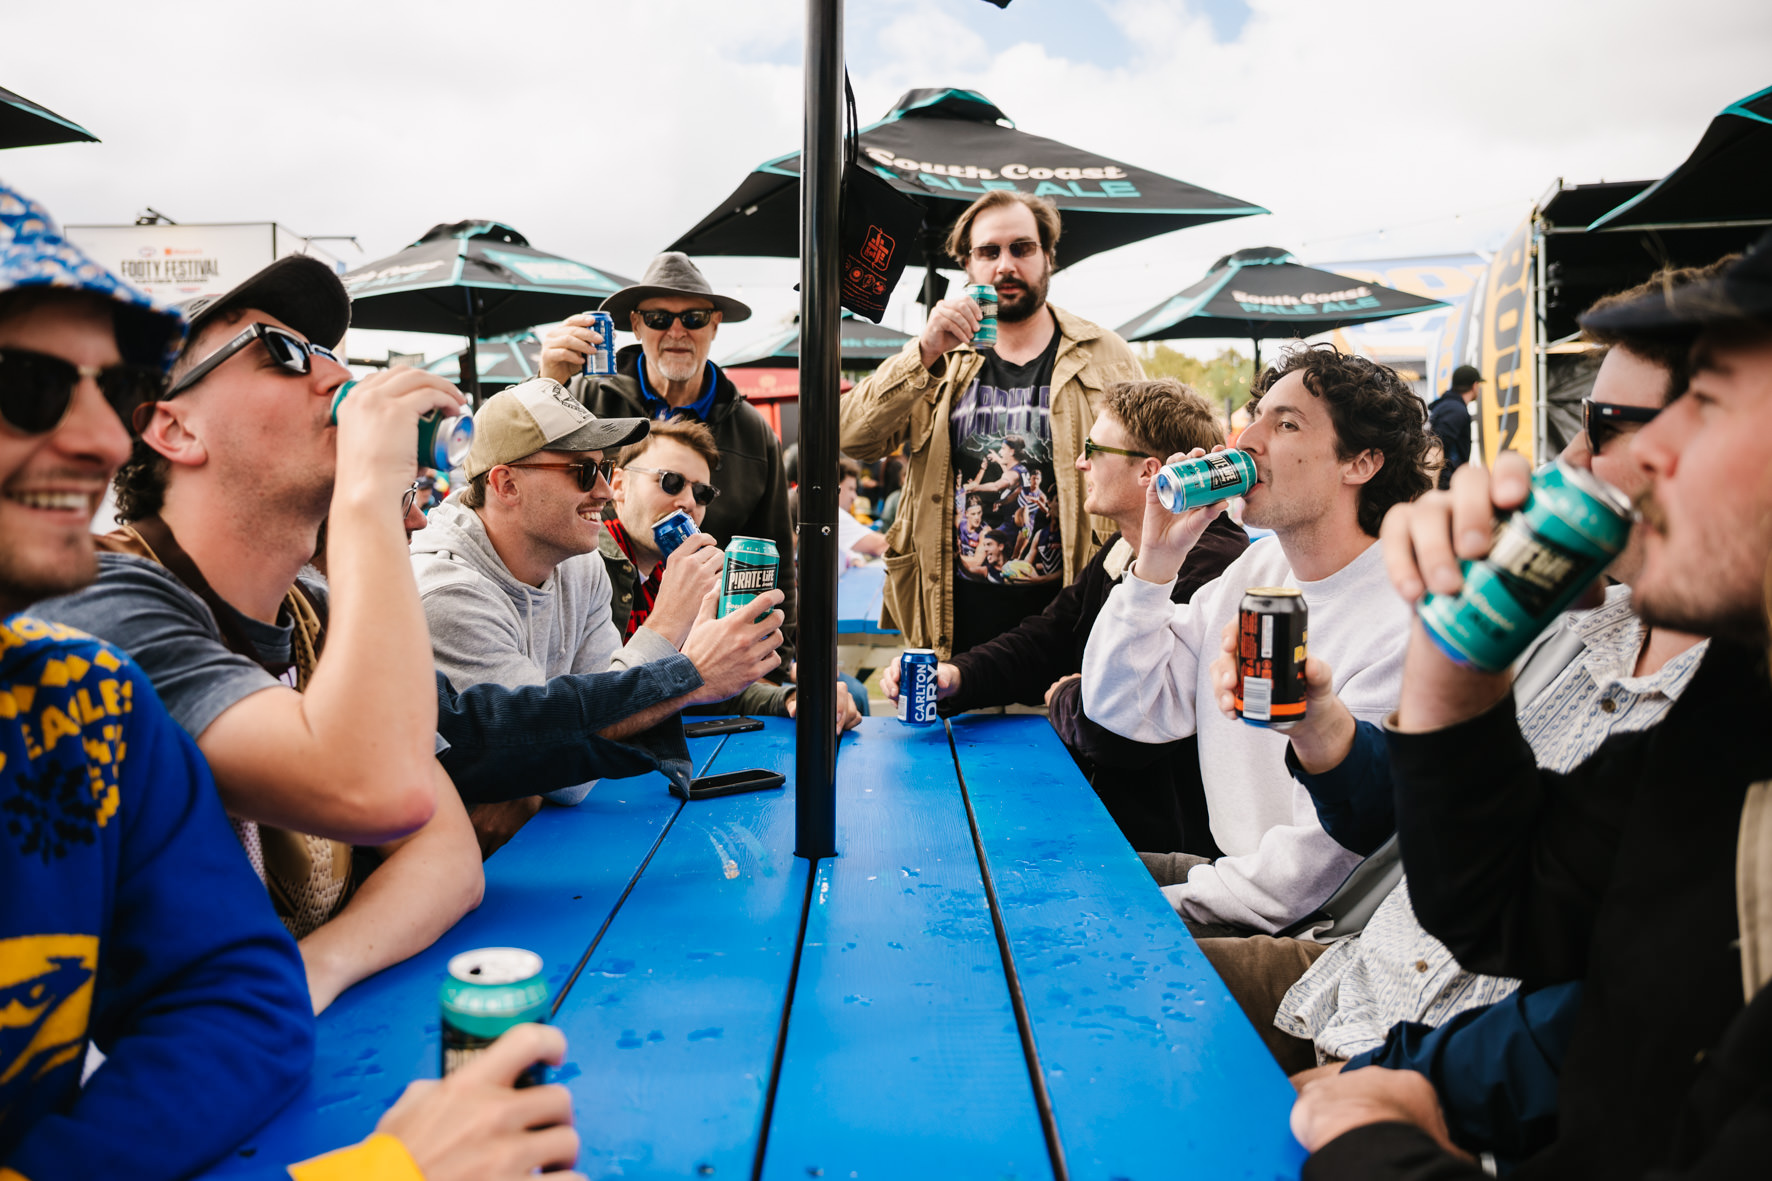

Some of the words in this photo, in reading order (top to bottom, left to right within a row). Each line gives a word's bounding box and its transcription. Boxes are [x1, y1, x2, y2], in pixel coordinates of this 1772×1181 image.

[865, 146, 1000, 180] South
[1000, 163, 1128, 181] Coast
[1033, 180, 1142, 198] ALE
[121, 260, 161, 277] FOOTY
[165, 259, 219, 277] FESTIVAL
[1322, 296, 1382, 313] ALE
[914, 664, 927, 722] CARLTON
[925, 664, 938, 721] DRY
